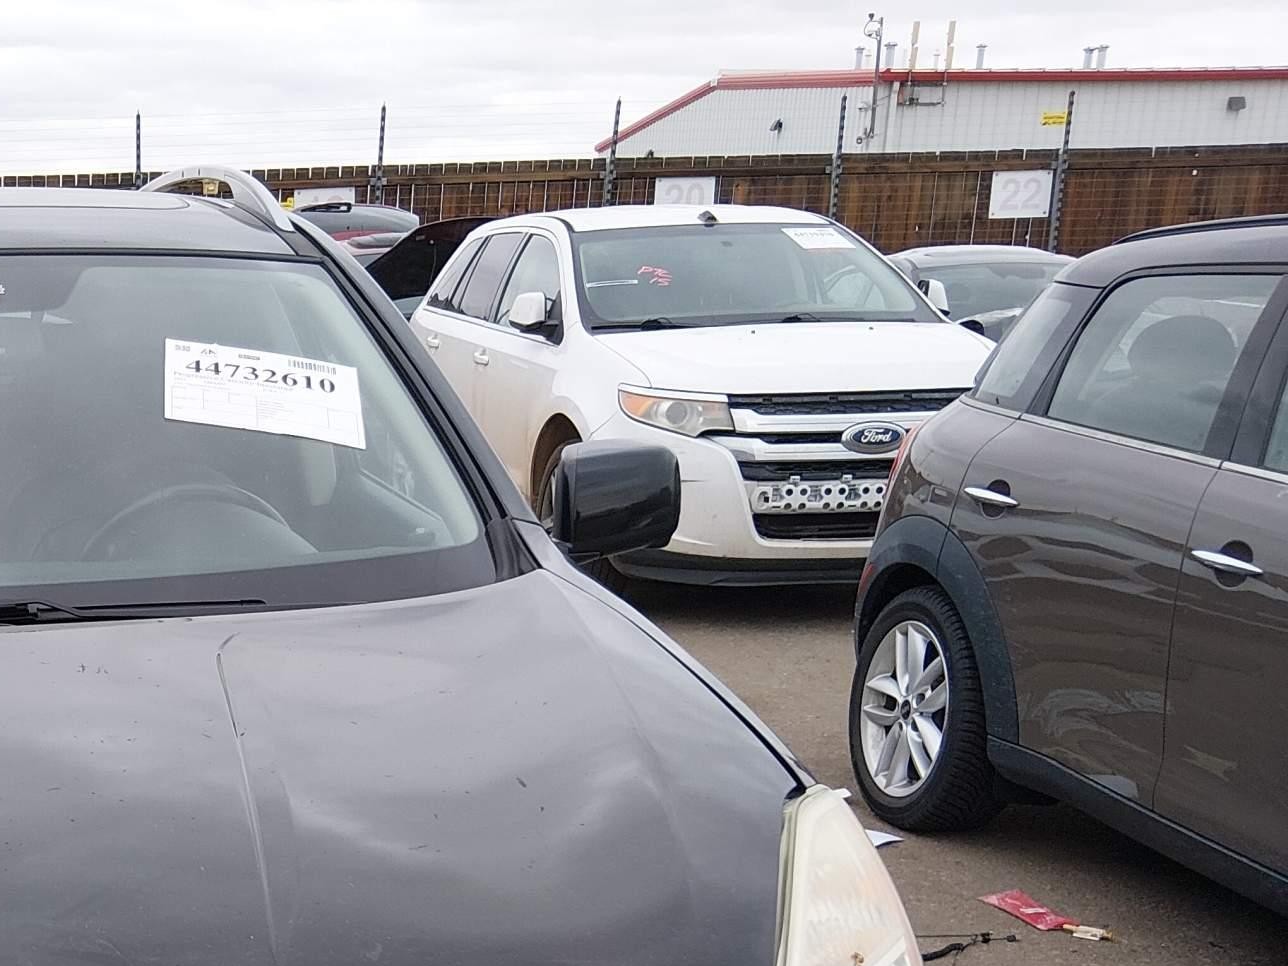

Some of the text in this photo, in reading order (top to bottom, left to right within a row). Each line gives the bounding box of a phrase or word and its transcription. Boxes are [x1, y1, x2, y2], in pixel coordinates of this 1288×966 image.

[998, 177, 1041, 211] 22
[185, 359, 336, 394] 44732610
[861, 428, 892, 443] Ford
